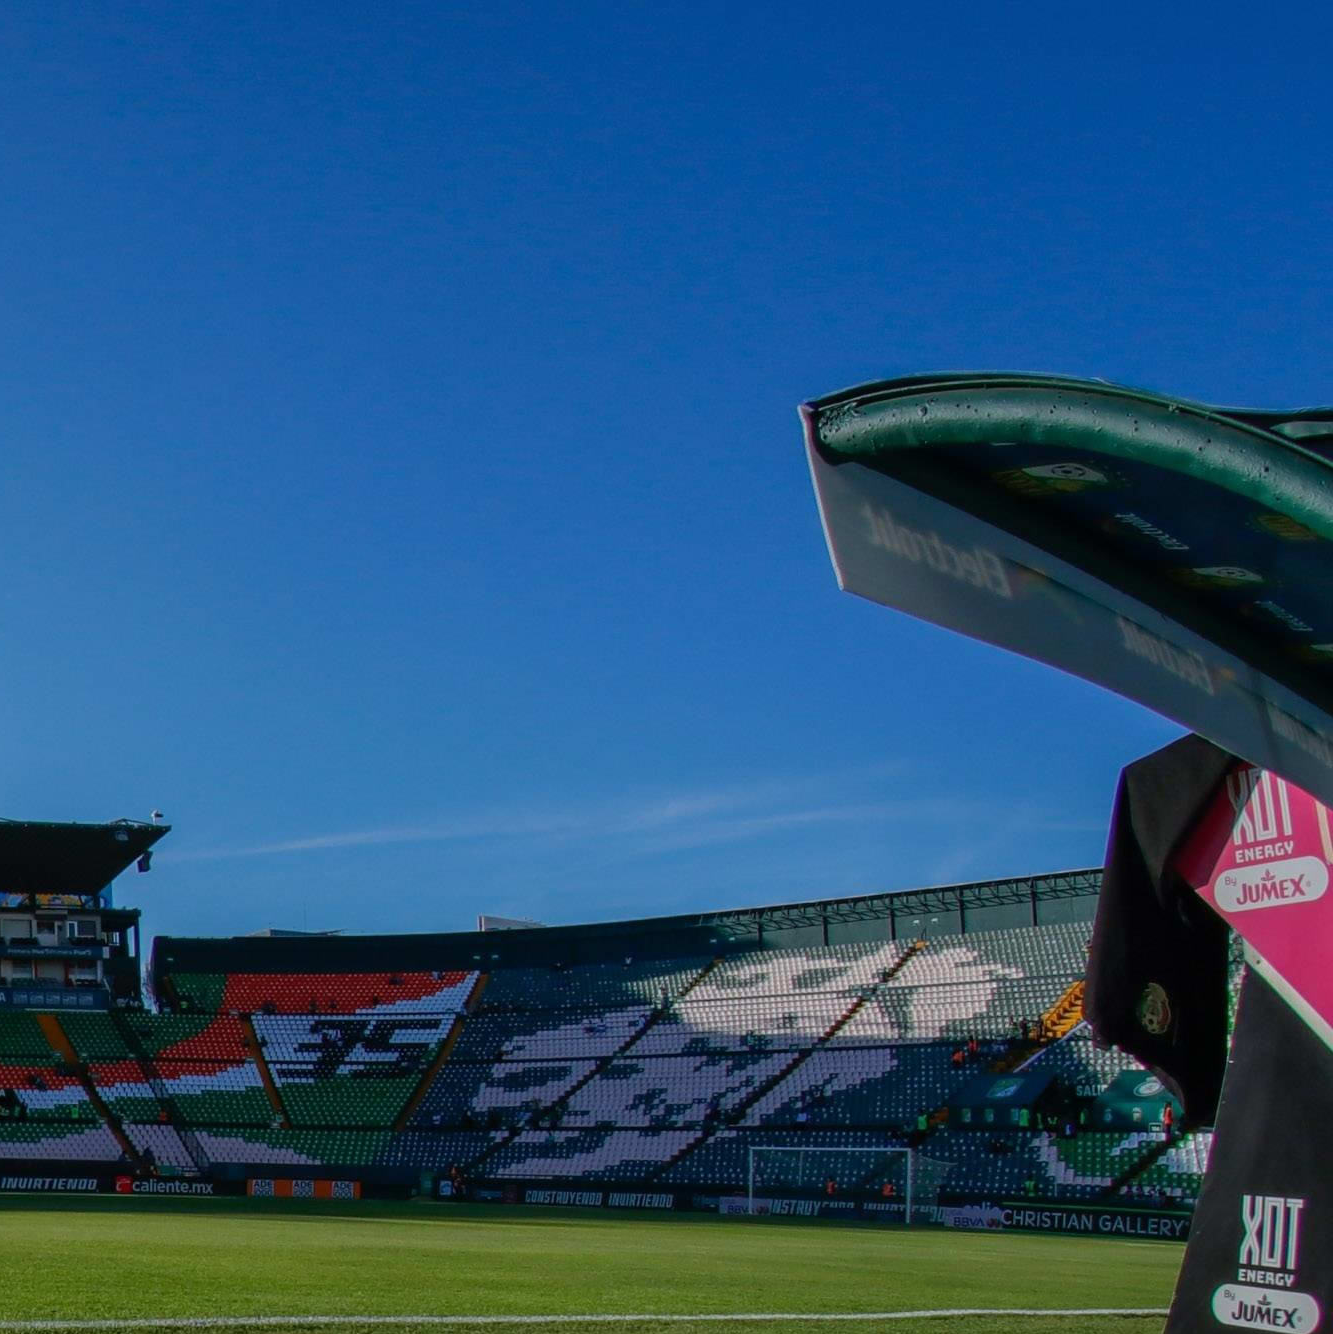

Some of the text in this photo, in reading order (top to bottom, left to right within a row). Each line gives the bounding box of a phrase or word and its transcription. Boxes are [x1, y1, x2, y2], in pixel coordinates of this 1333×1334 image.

[1235, 841, 1294, 864] ENERGY
[1225, 877, 1237, 887] By
[1236, 874, 1306, 905] JUMEX
[132, 1180, 213, 1195] caliente.mx
[1002, 1209, 1183, 1236] CHRISTIAN GALLERY
[1239, 1195, 1304, 1270] XOT
[1237, 1269, 1295, 1287] ENERGY
[1224, 1290, 1236, 1300] By
[1232, 1301, 1298, 1329] JUMEX
